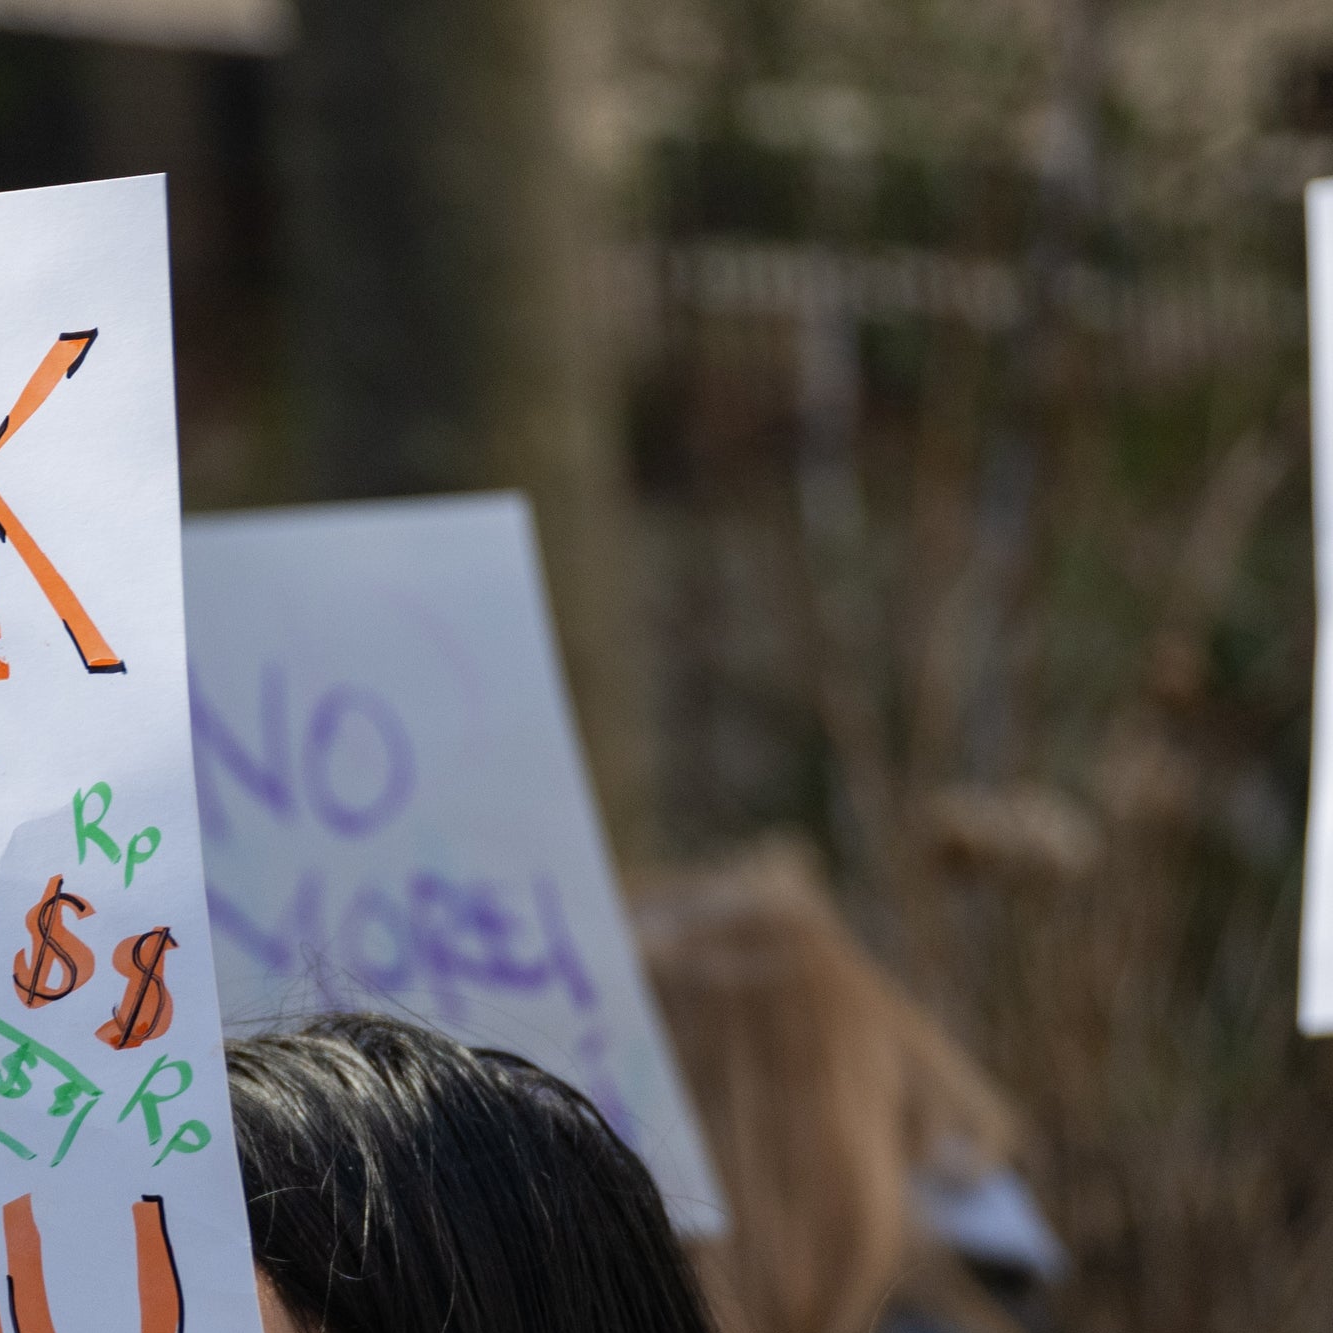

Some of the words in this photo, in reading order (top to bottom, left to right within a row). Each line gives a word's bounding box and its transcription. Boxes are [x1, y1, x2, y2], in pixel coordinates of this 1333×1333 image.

[186, 660, 417, 844] NO
[73, 781, 162, 889] Rp
[117, 1053, 212, 1167] Rp
